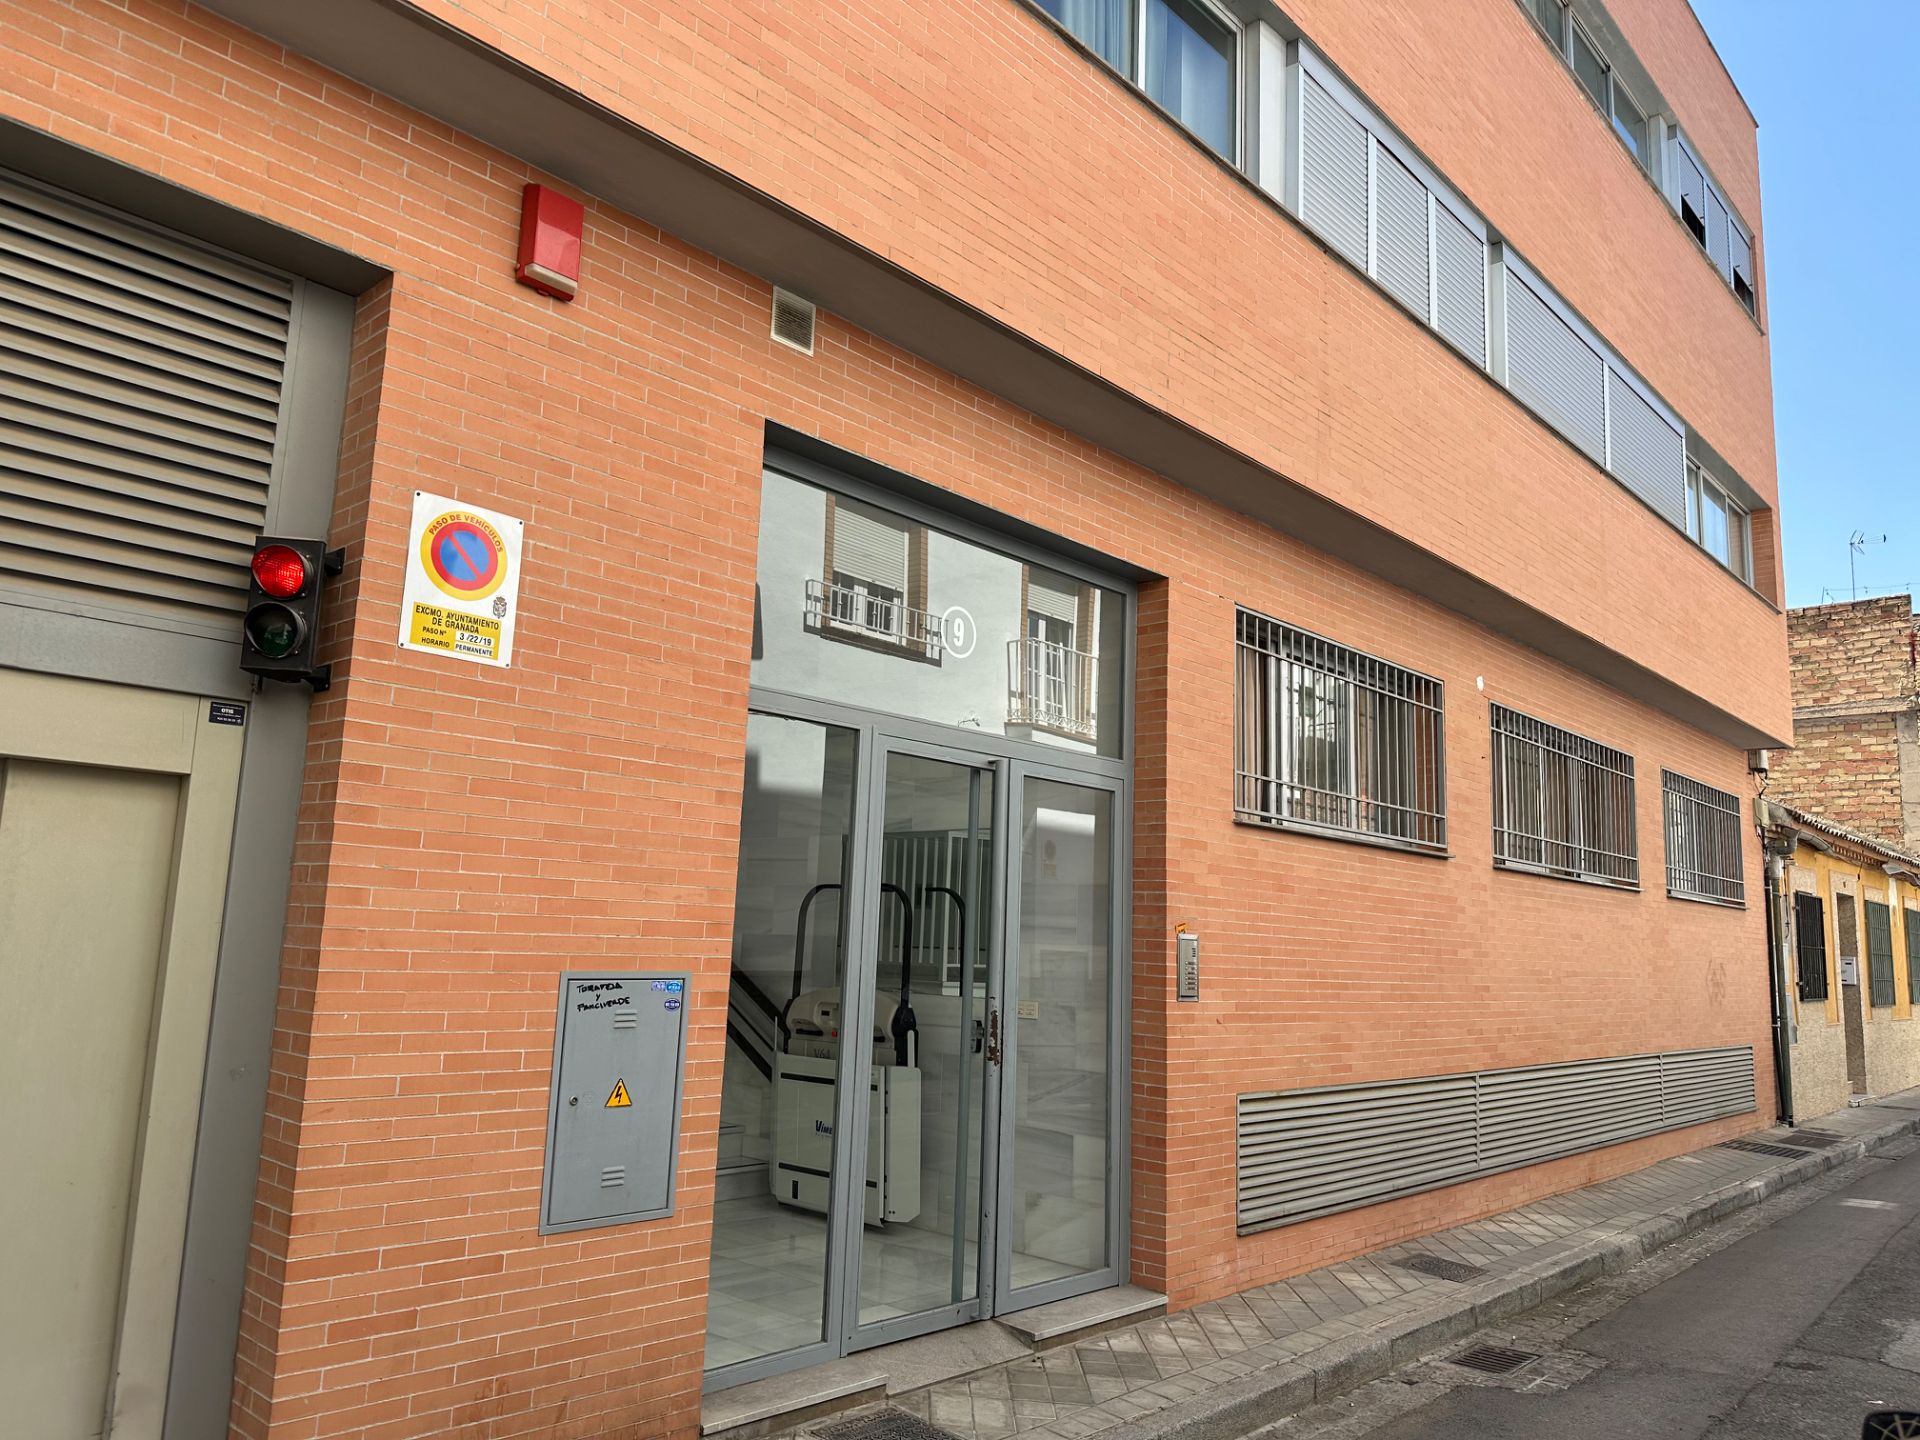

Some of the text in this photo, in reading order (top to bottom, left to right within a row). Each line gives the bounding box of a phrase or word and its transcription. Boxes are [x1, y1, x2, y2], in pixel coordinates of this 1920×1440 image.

[428, 517, 448, 535] PASO
[415, 605, 499, 630] EXCMO. AYUNTAMIENTO
[432, 617, 479, 634] DE GRANADA
[422, 626, 438, 635] PASO
[953, 617, 965, 647] 9
[421, 637, 493, 656] HORARIO PERMANENTE
